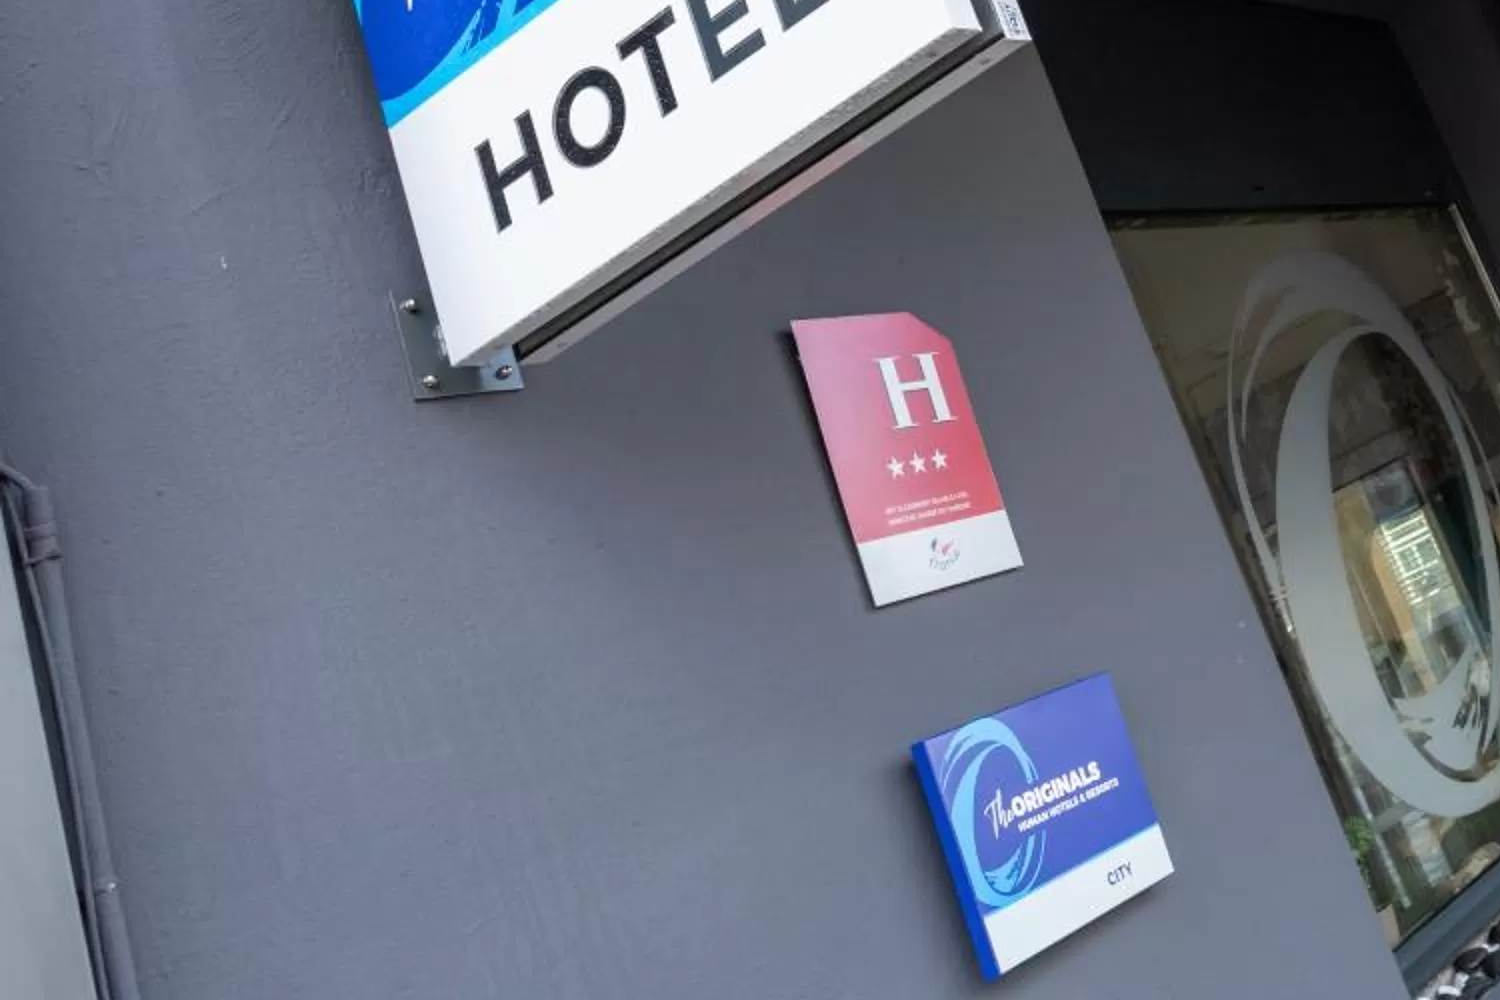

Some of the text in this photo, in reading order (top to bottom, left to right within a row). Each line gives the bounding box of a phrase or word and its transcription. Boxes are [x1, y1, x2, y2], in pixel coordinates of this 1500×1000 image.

[872, 352, 959, 430] H
[984, 761, 1101, 839] The ORIGINALS
[1107, 861, 1132, 885] CITY
